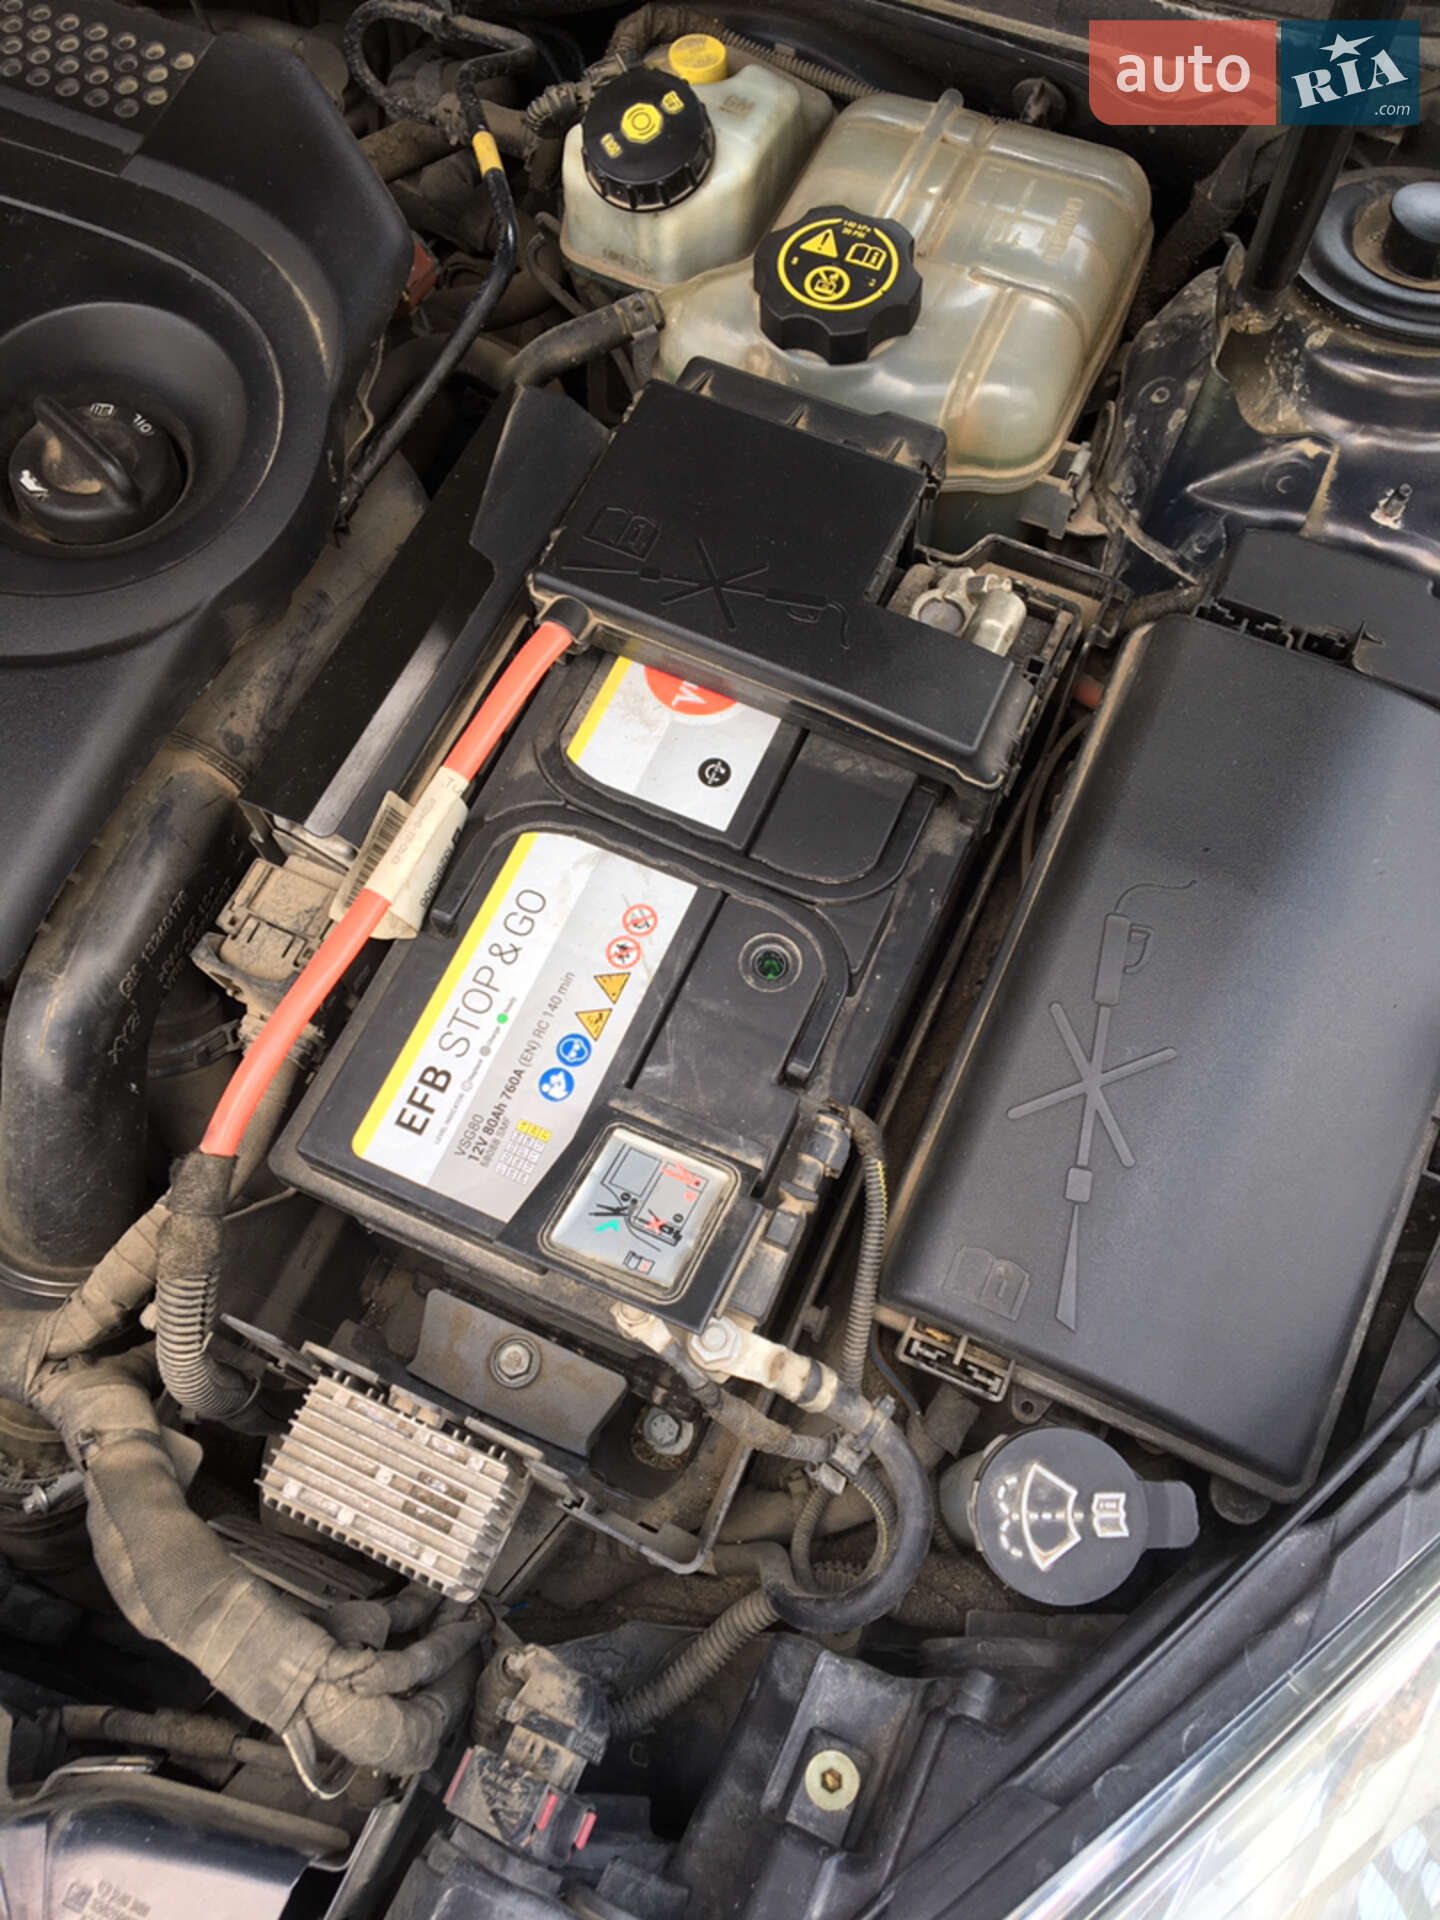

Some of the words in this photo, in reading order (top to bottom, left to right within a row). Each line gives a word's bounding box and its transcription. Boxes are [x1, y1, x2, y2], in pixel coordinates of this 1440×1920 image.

[132, 412, 151, 433] OIL
[503, 889, 547, 937] GO
[488, 943, 522, 965] &
[438, 966, 501, 1058] STOP
[468, 1135, 490, 1163] 12V
[481, 1100, 508, 1136] 80Ah
[499, 1065, 526, 1101] 760A
[517, 1037, 542, 1068] (EN)
[531, 1018, 550, 1039] RC
[542, 994, 563, 1019] 140
[554, 969, 576, 996] min
[395, 1066, 453, 1137] EFB
[453, 1112, 485, 1158] VSG80
